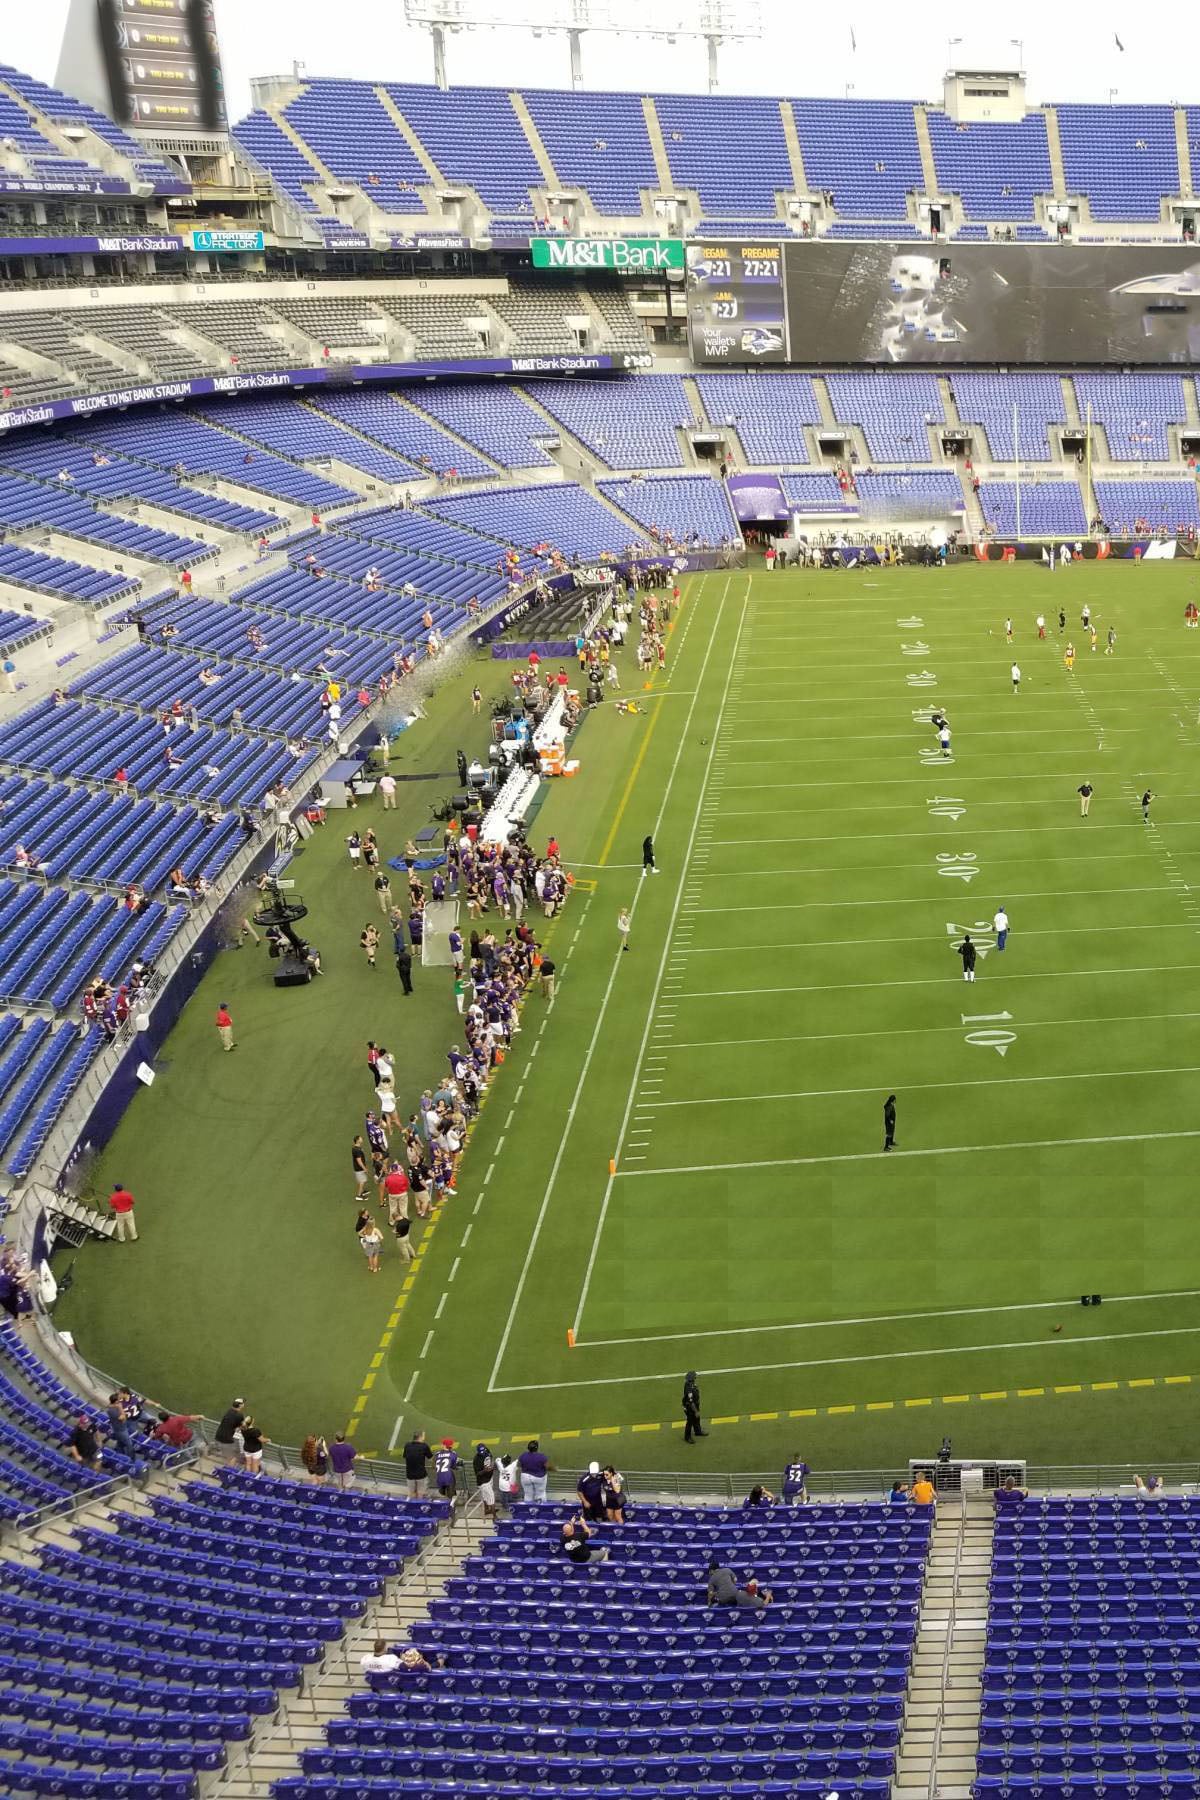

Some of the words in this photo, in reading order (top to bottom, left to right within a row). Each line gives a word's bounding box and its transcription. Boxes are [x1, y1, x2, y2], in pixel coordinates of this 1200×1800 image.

[97, 238, 122, 250] M&T
[122, 239, 144, 250] Bank
[143, 238, 179, 250] Stadium
[212, 239, 259, 249] FACTORY
[546, 241, 611, 266] M&T
[612, 241, 672, 266] Bank
[741, 248, 780, 259] PREGAME
[744, 260, 778, 277] 27:21
[702, 328, 722, 337] Your
[703, 336, 736, 346] wallet's
[511, 358, 537, 371] M&T
[536, 358, 558, 369] Bank
[559, 357, 599, 369] Stadium
[213, 376, 236, 391] M&T
[235, 375, 257, 389] Bank
[256, 373, 290, 386] Stadium
[72, 396, 108, 412] WELCOME
[108, 394, 118, 406] TO
[118, 391, 132, 405] M&T
[133, 388, 155, 402] BANK
[155, 382, 191, 399] STADIUM
[11, 410, 29, 426] Bank
[27, 408, 54, 424] Stadium
[926, 795, 967, 816] 40
[935, 852, 980, 877] 30
[946, 921, 997, 951] 20
[961, 1010, 1017, 1047] 10
[436, 1458, 449, 1473] 52
[789, 1469, 802, 1482] 52
